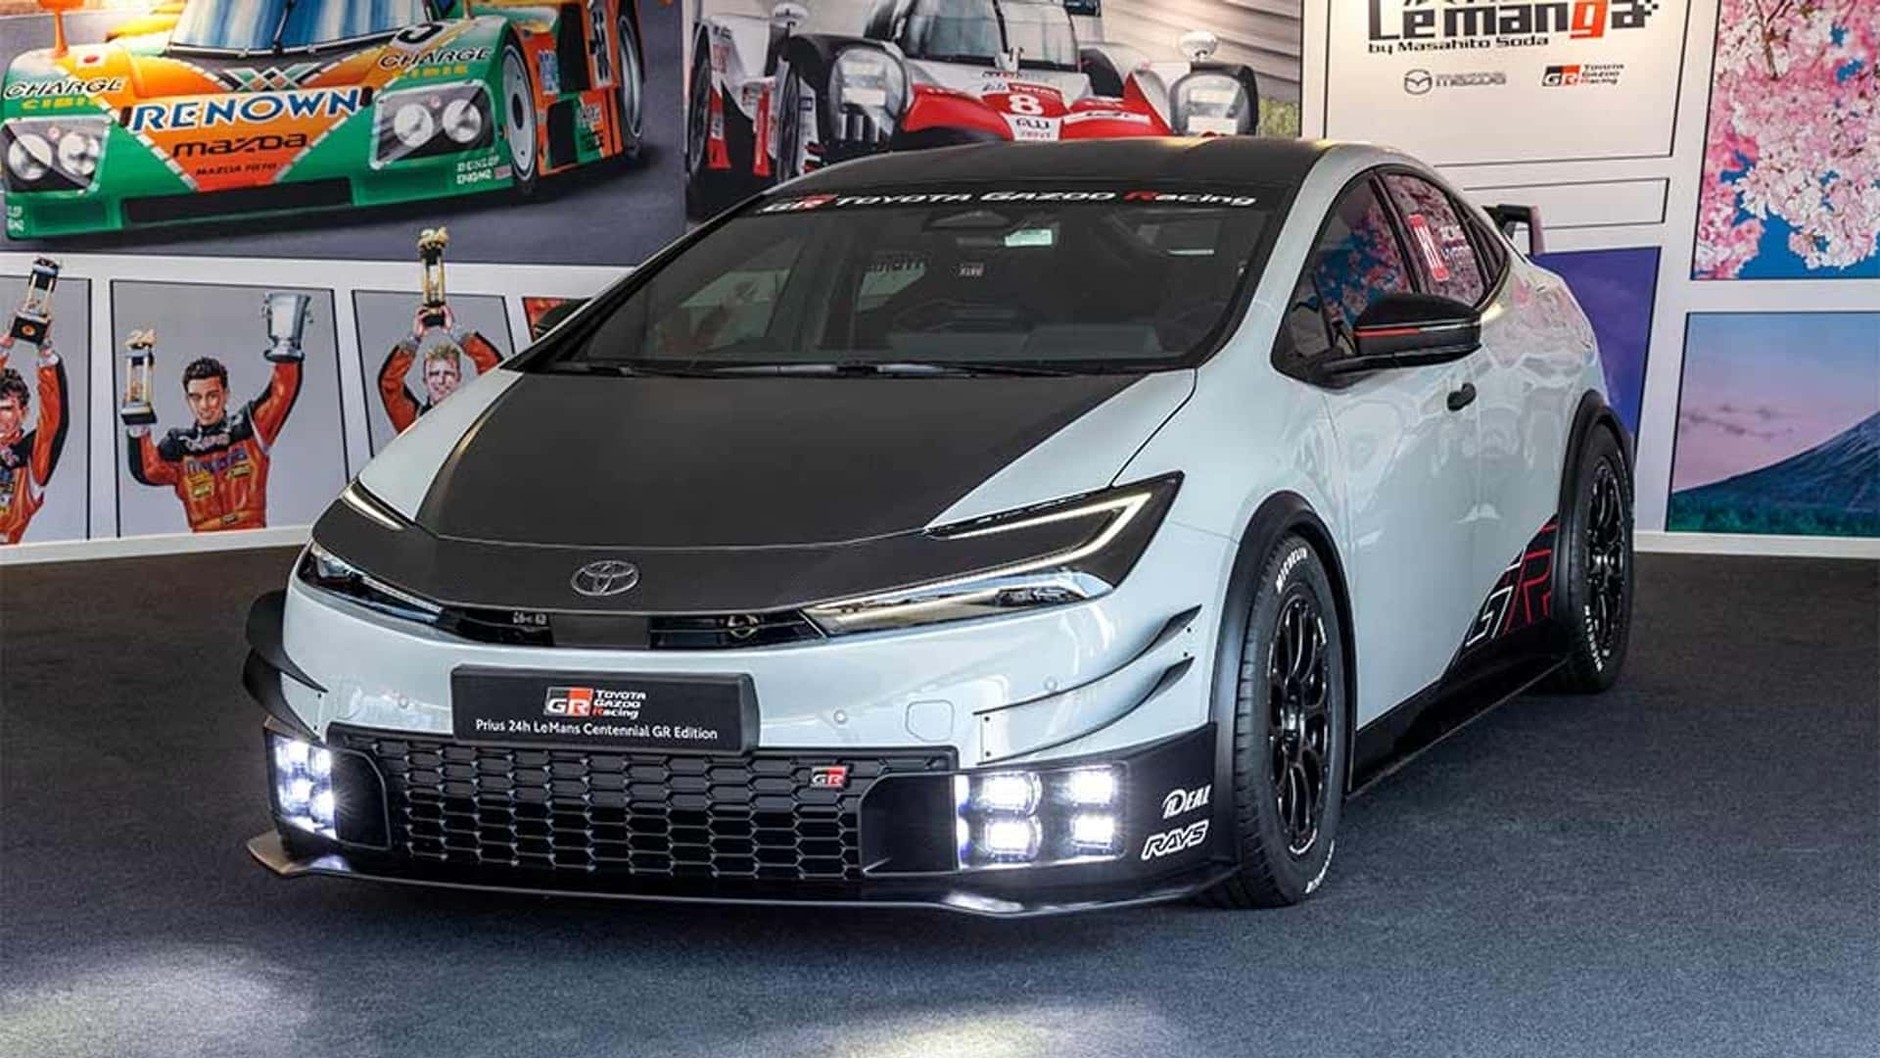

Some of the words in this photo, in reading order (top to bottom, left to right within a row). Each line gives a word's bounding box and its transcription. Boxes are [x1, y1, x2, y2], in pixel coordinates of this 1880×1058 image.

[1368, 43, 1393, 54] by
[1398, 38, 1491, 52] Masahito
[1496, 35, 1549, 48] Soda
[131, 88, 360, 132] RENOWN
[1008, 94, 1044, 116] 8
[172, 133, 308, 158] mazda
[836, 193, 973, 206] TOYOTA
[980, 191, 1117, 202] GAZOO
[1123, 190, 1257, 206] Racing
[593, 699, 641, 709] GAZOO
[595, 690, 646, 700] TOYOTA
[592, 708, 639, 720] Racing
[476, 719, 505, 732] Prius
[509, 720, 531, 733] 24h
[533, 721, 581, 735] LeMans
[583, 723, 650, 738] Centennial
[652, 725, 671, 738] GR
[674, 726, 718, 740] Edition
[1141, 819, 1209, 860] RAYS
